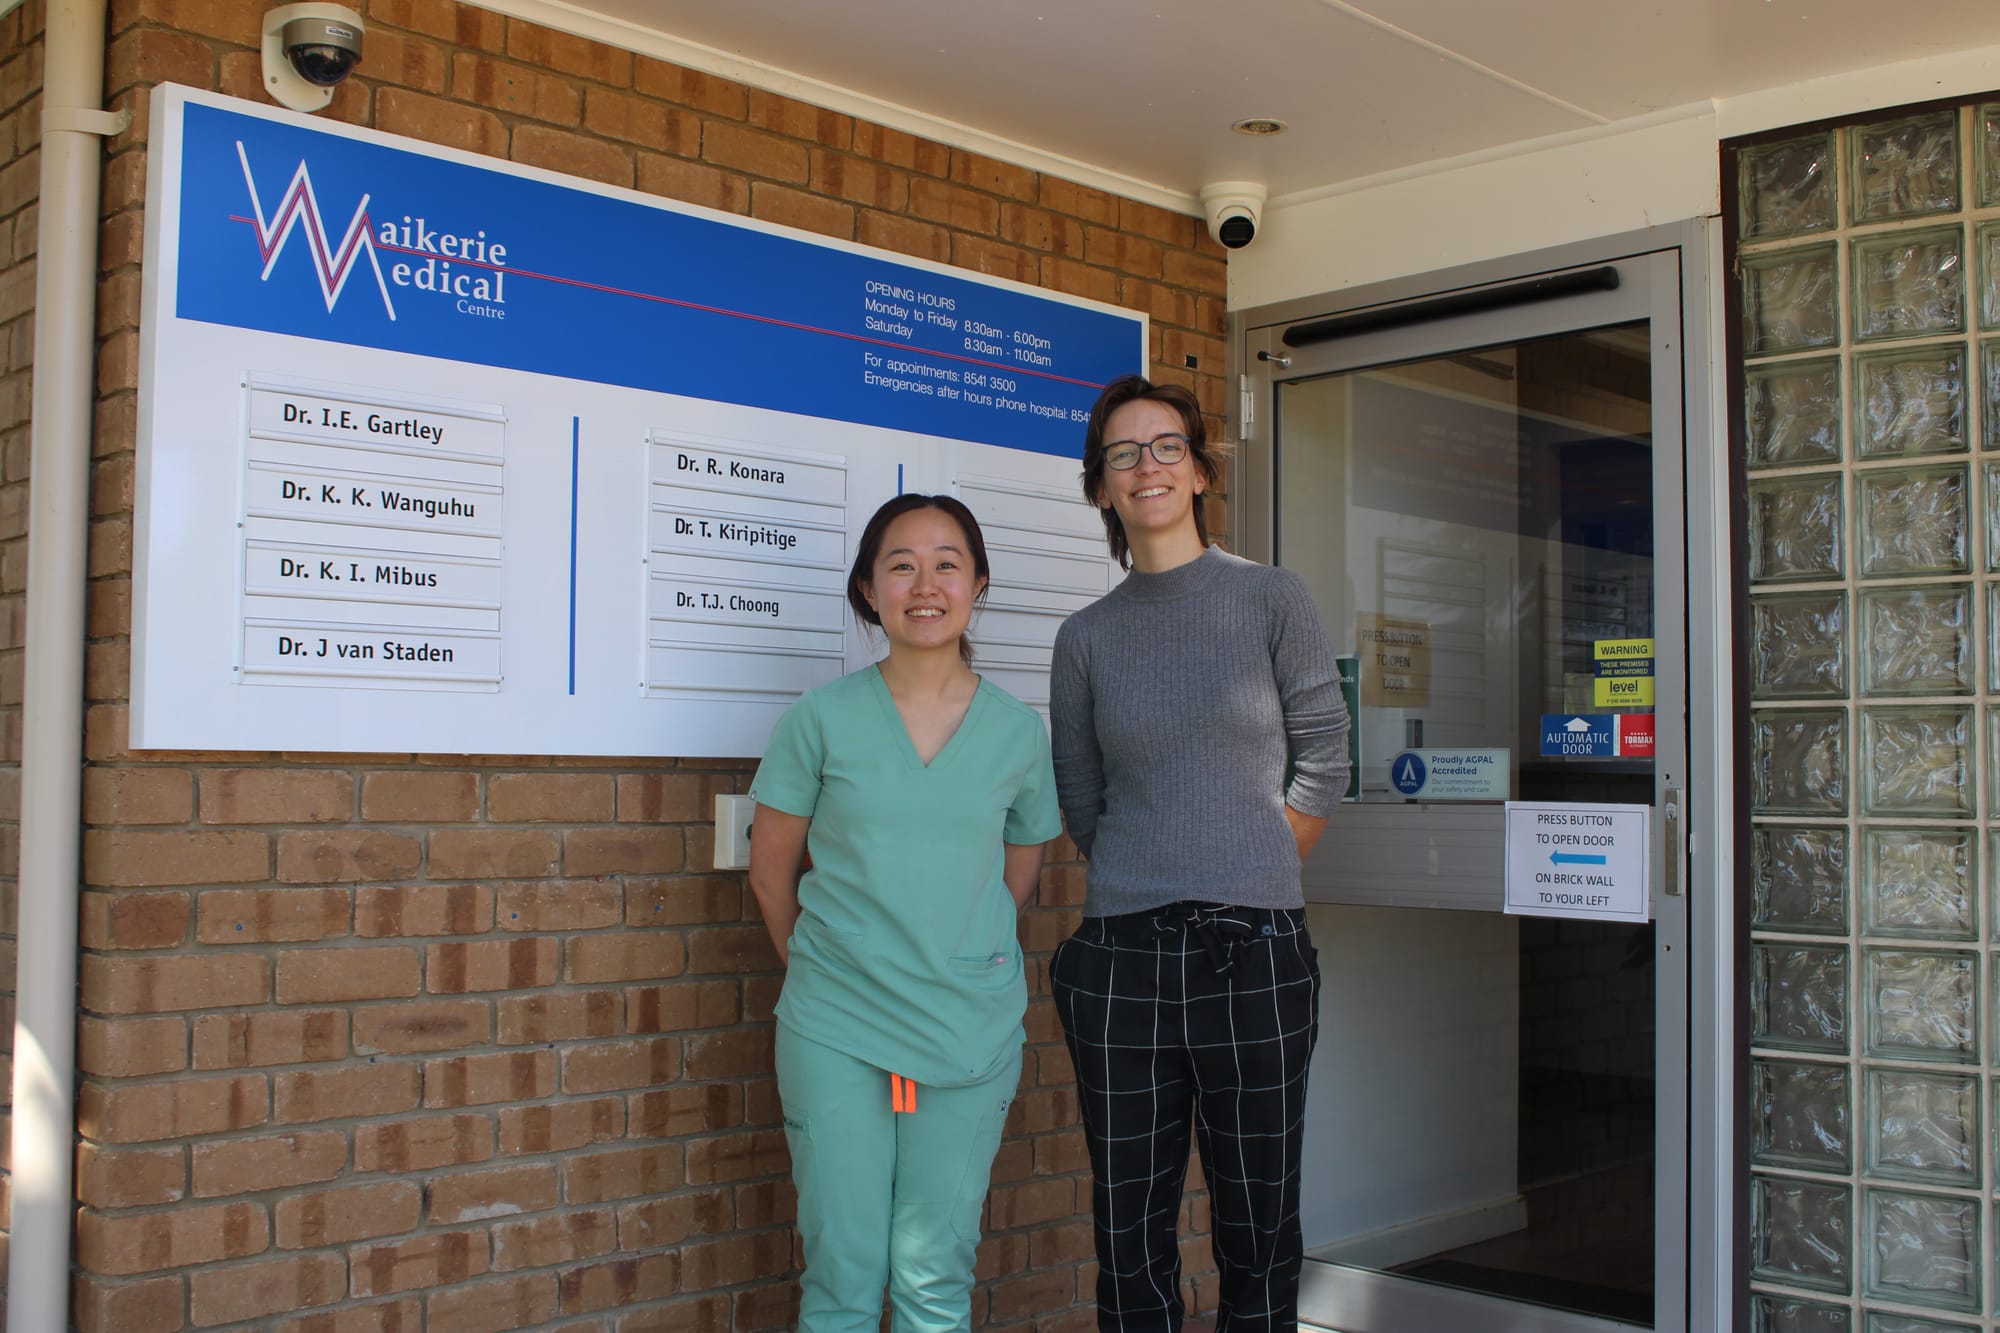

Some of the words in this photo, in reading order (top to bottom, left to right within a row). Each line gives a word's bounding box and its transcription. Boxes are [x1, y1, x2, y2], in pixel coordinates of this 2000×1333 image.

[865, 280, 914, 302] OPENING
[918, 292, 956, 311] HOURS
[456, 299, 505, 320] Centre
[865, 298, 909, 321] Monday
[914, 310, 924, 321] to
[928, 312, 958, 331] Friday
[964, 320, 1003, 339] 8.30am
[1014, 331, 1051, 350] 6.00pm
[865, 317, 913, 340] Saturday
[964, 338, 1002, 357] 8.30am
[1014, 348, 1052, 367] 11.00am
[864, 352, 882, 368] For
[887, 358, 960, 382] appointments:
[964, 372, 986, 387] 8541
[990, 377, 1016, 393] 3500
[864, 371, 933, 395] Emergencies
[937, 386, 959, 400] after
[964, 390, 992, 406] hours
[996, 397, 1026, 413] phone
[1030, 401, 1068, 420] hospital:
[284, 403, 312, 425] Dr.
[322, 408, 358, 430] I.E.
[367, 414, 443, 445] Gartley
[677, 454, 699, 472] Dr.
[707, 458, 722, 475] R.
[730, 461, 785, 484] Konara
[282, 480, 311, 501] Dr.
[321, 484, 341, 504] K.
[352, 488, 371, 508] K.
[381, 491, 475, 518] Wanguhu
[675, 518, 693, 535] Dr.
[699, 521, 712, 538] T.
[720, 523, 797, 550] Kiripitige
[280, 558, 309, 579] Dr.
[320, 561, 340, 580] K.
[350, 564, 365, 582] I.
[376, 565, 437, 587] Mibus
[677, 592, 695, 608] Dr.
[701, 594, 724, 610] T.J.
[730, 595, 779, 617] Choong
[278, 636, 308, 656] Dr.
[316, 638, 327, 657] J
[337, 642, 373, 659] van
[383, 642, 454, 662] Staden
[1600, 645, 1648, 656] WARNING
[1610, 680, 1638, 693] level
[1546, 732, 1609, 744] AUTOMATIC
[1562, 744, 1592, 755] DOOR
[1624, 735, 1654, 745] TORMAX
[1432, 756, 1463, 765] Proudly
[1465, 756, 1494, 764] AGPAL
[1432, 767, 1477, 775] Accredited
[1537, 814, 1568, 825] PRESS
[1570, 815, 1613, 826] BUTTON
[1536, 833, 1549, 844] TO
[1552, 834, 1580, 845] OPEN
[1583, 835, 1614, 846] DOOR
[1535, 872, 1550, 883] ON
[1554, 873, 1583, 885] BRICK
[1586, 875, 1614, 887] WALL
[1539, 892, 1552, 903] TO
[1555, 893, 1583, 905] YOUR
[1586, 895, 1610, 906] LEFT
